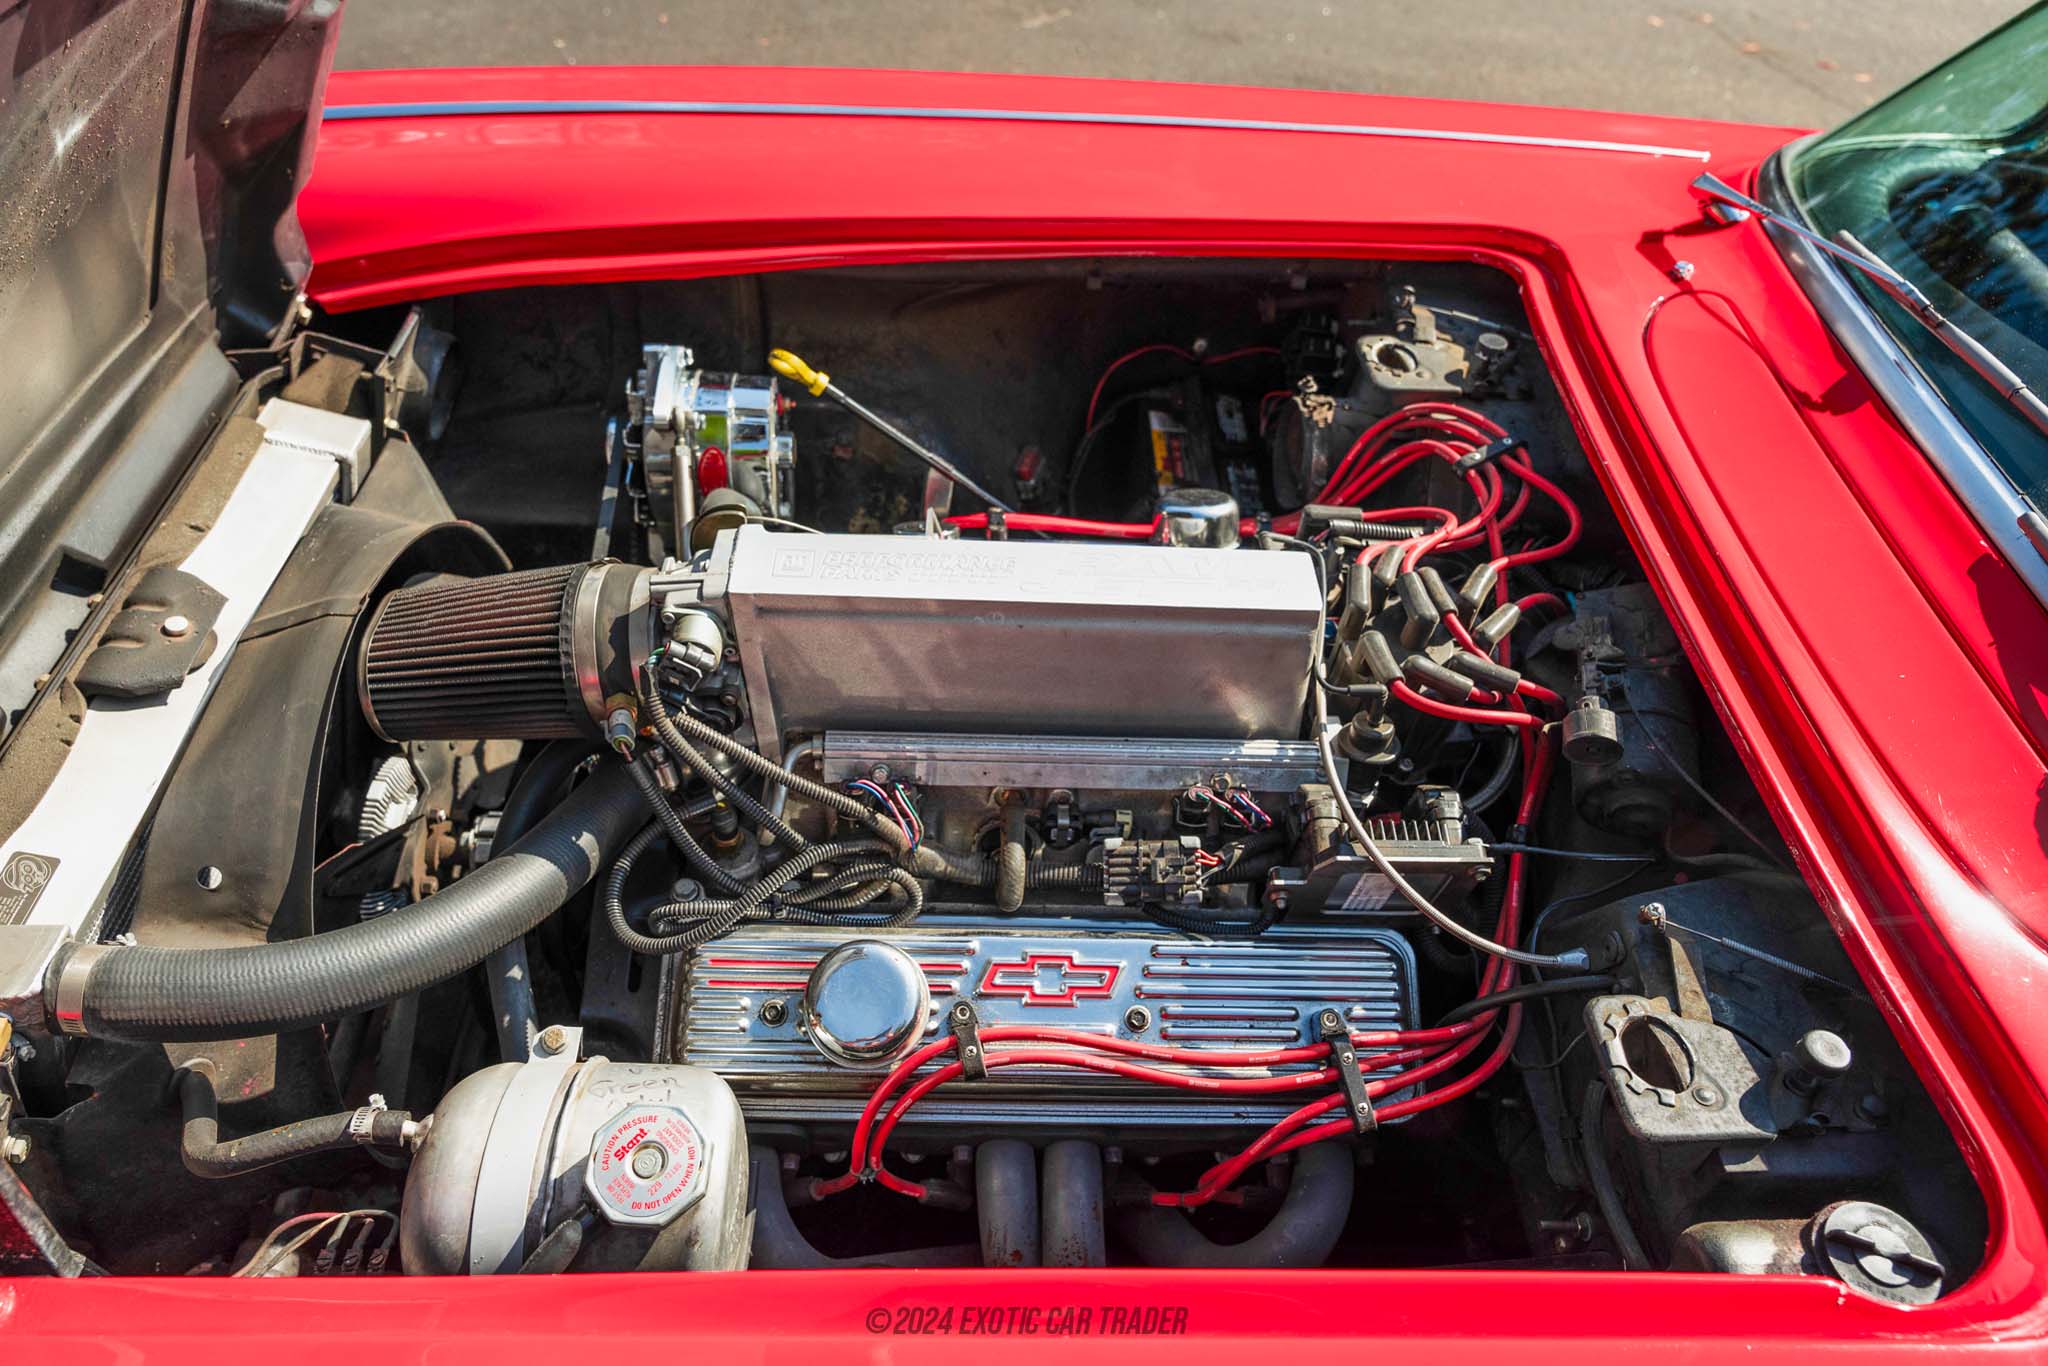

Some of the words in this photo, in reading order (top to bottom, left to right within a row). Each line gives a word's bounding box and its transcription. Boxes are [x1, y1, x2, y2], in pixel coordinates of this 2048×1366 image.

[600, 1135, 619, 1172] CAUTION
[617, 1114, 659, 1135] PRESSURE
[613, 1127, 649, 1162] Stant
[631, 1201, 643, 1210] DO
[644, 1199, 661, 1210] NOT
[663, 1187, 682, 1205] OPEN
[678, 1163, 695, 1188] WHEN
[687, 1143, 696, 1161] HOT
